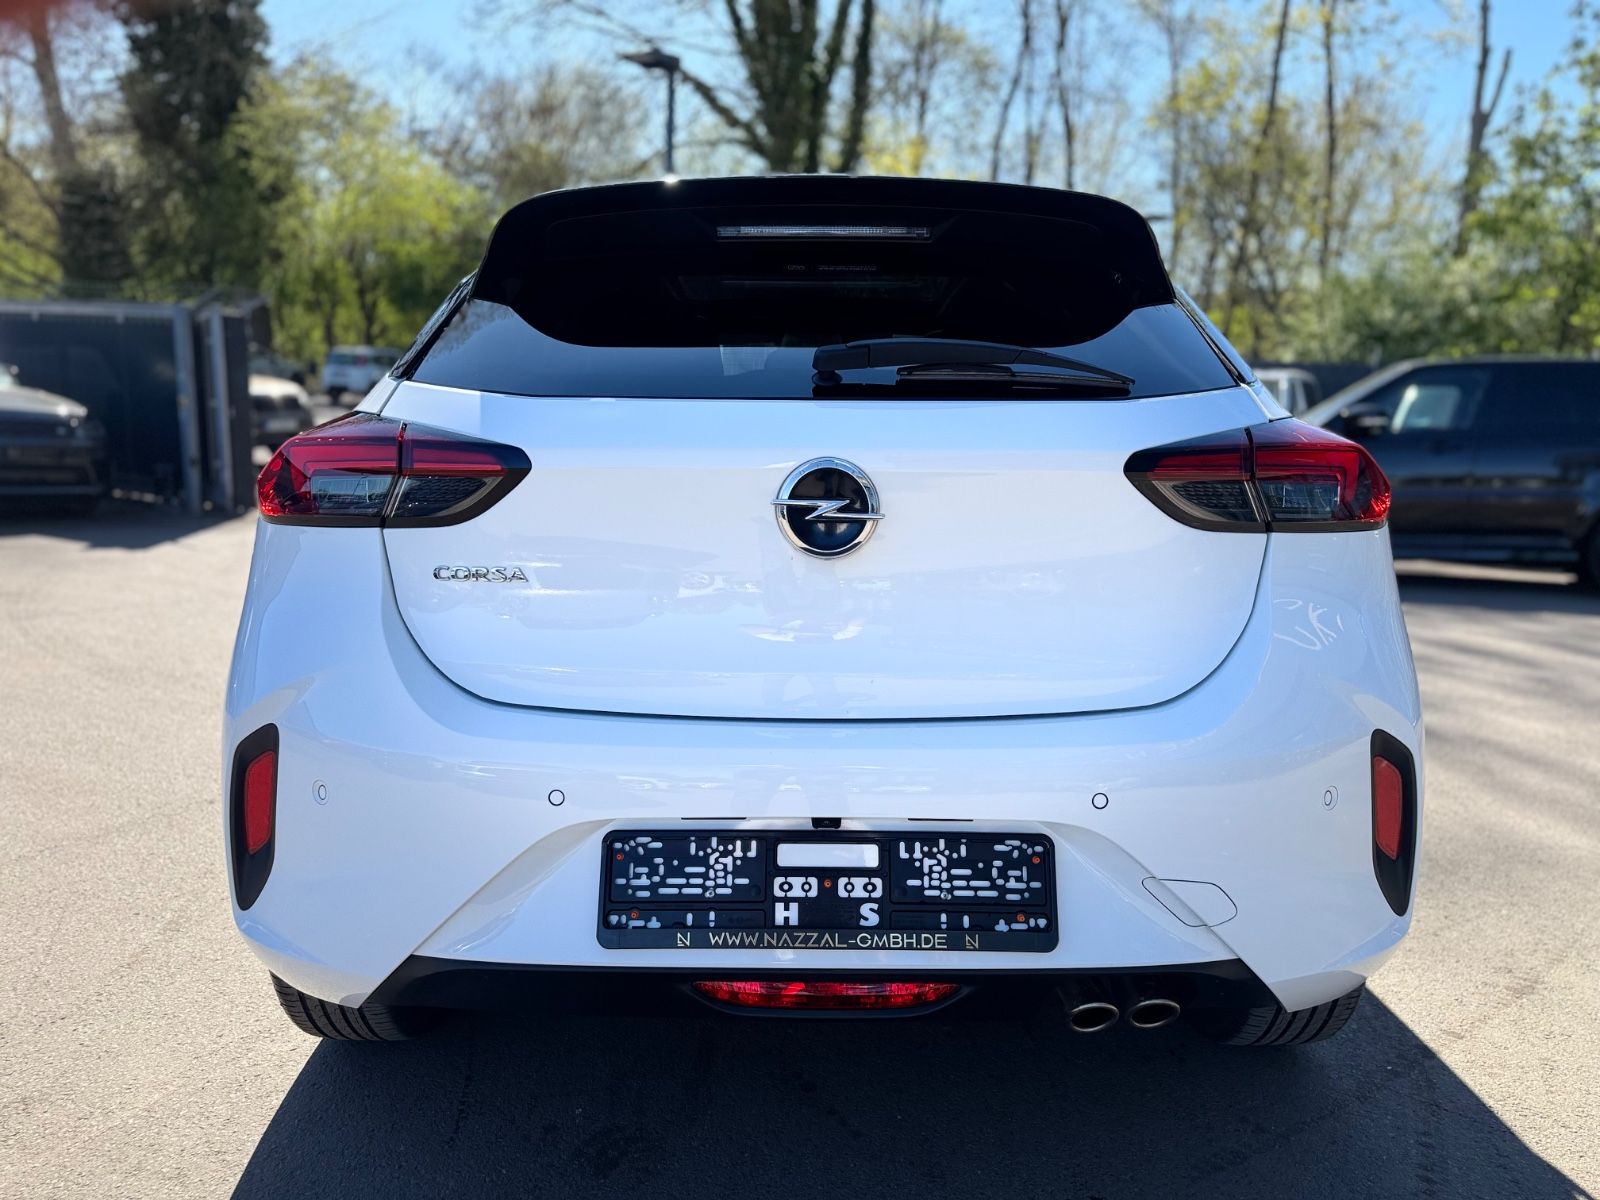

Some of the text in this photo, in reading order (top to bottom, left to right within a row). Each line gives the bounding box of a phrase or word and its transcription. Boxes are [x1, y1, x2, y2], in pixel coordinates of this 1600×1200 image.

[433, 565, 529, 583] CORSA
[774, 902, 880, 927] H S
[708, 931, 948, 949] WWW.NAZZAL-GMBH.DE
